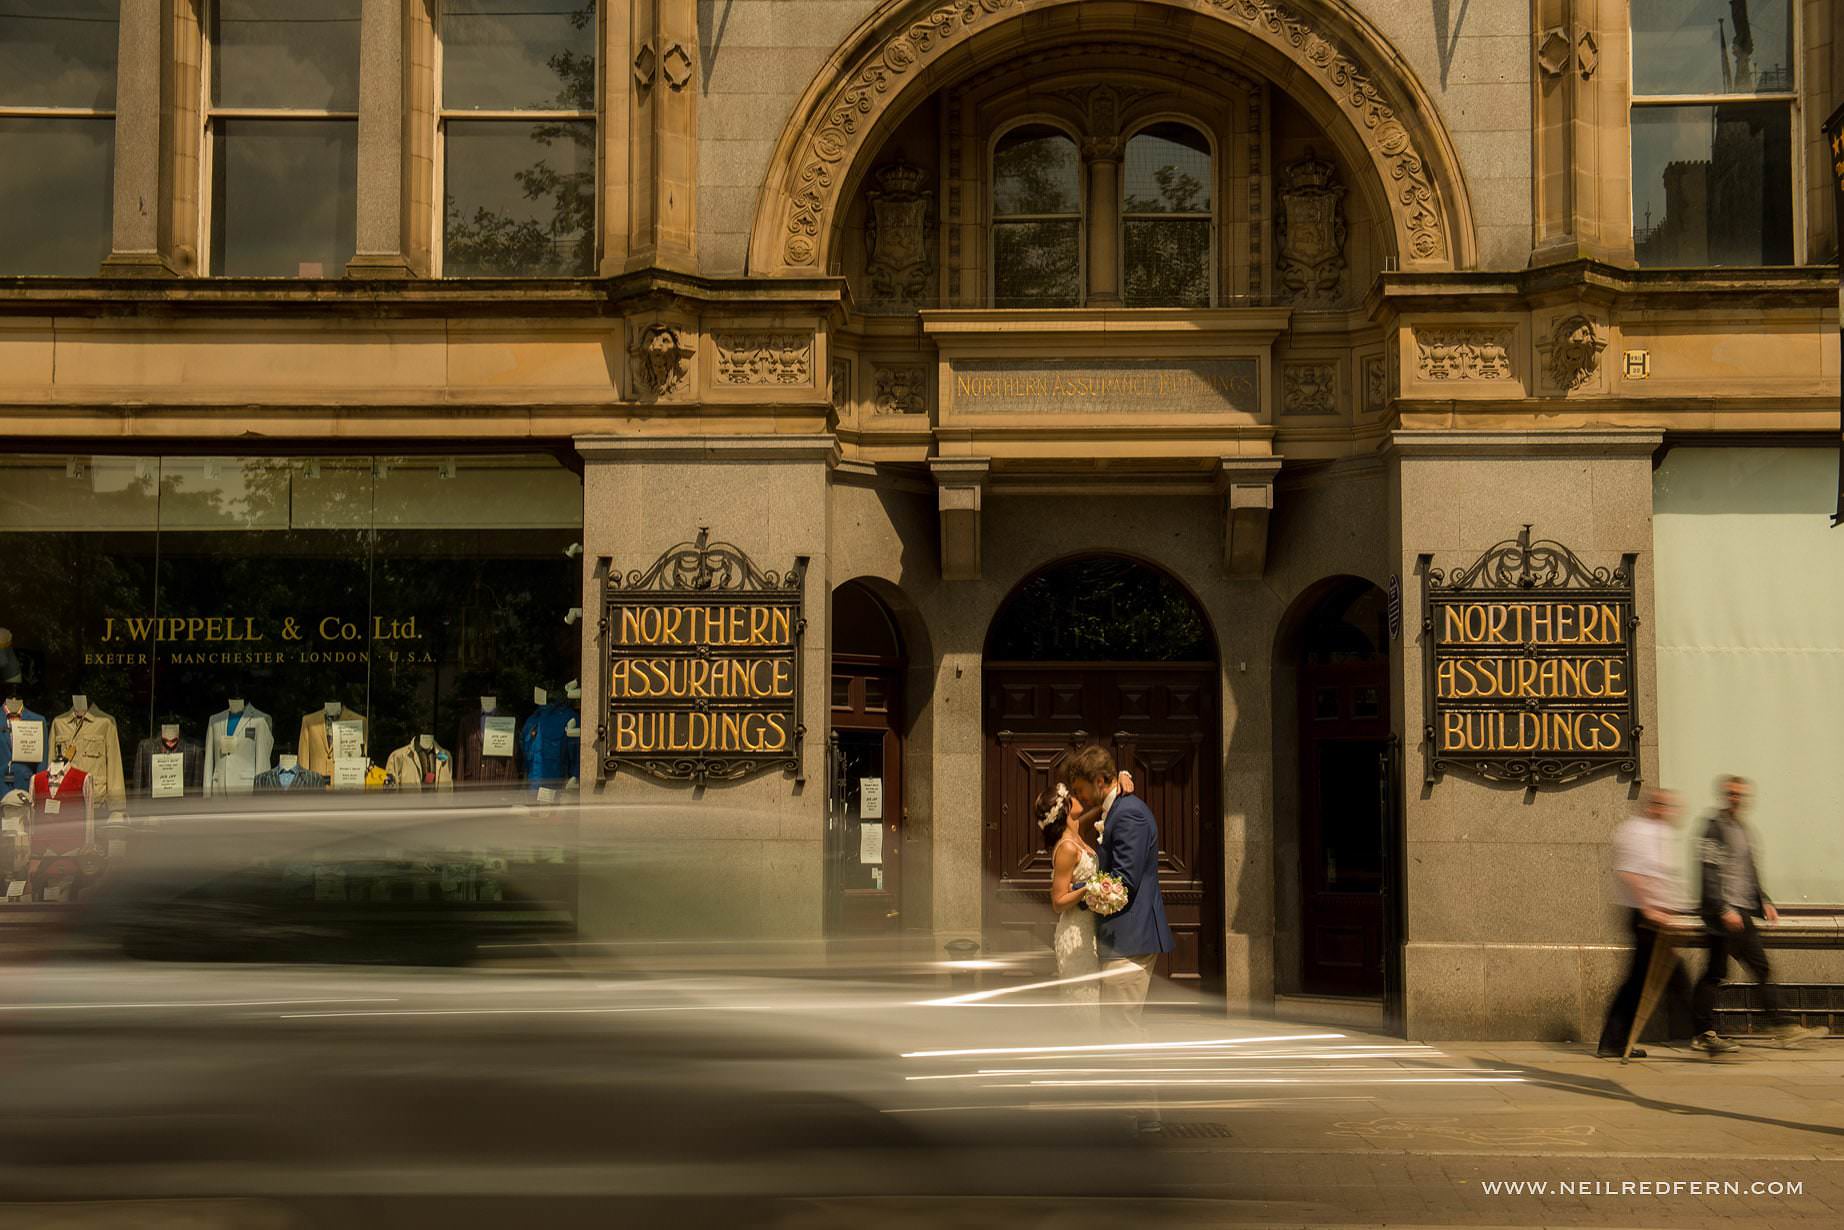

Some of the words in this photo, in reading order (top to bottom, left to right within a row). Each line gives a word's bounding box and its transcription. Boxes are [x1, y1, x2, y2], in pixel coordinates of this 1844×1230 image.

[957, 374, 1047, 397] NORTHERN
[1052, 374, 1153, 397] ASSURANCE
[281, 616, 303, 641] &
[319, 616, 362, 641] Co.
[372, 615, 422, 641] Ltd.
[620, 606, 790, 645] NORTHERN
[1442, 604, 1622, 643] NORTHERN
[85, 653, 147, 665] EXETER
[171, 652, 285, 664] MANCHESTER
[301, 651, 370, 664] LONDON
[389, 651, 437, 664] U.S.A.
[1437, 658, 1627, 697] ASSURANCE
[610, 658, 793, 698] ASSURANCE
[616, 712, 786, 751] BUILDINGS
[1444, 712, 1622, 751] BUILDINGS
